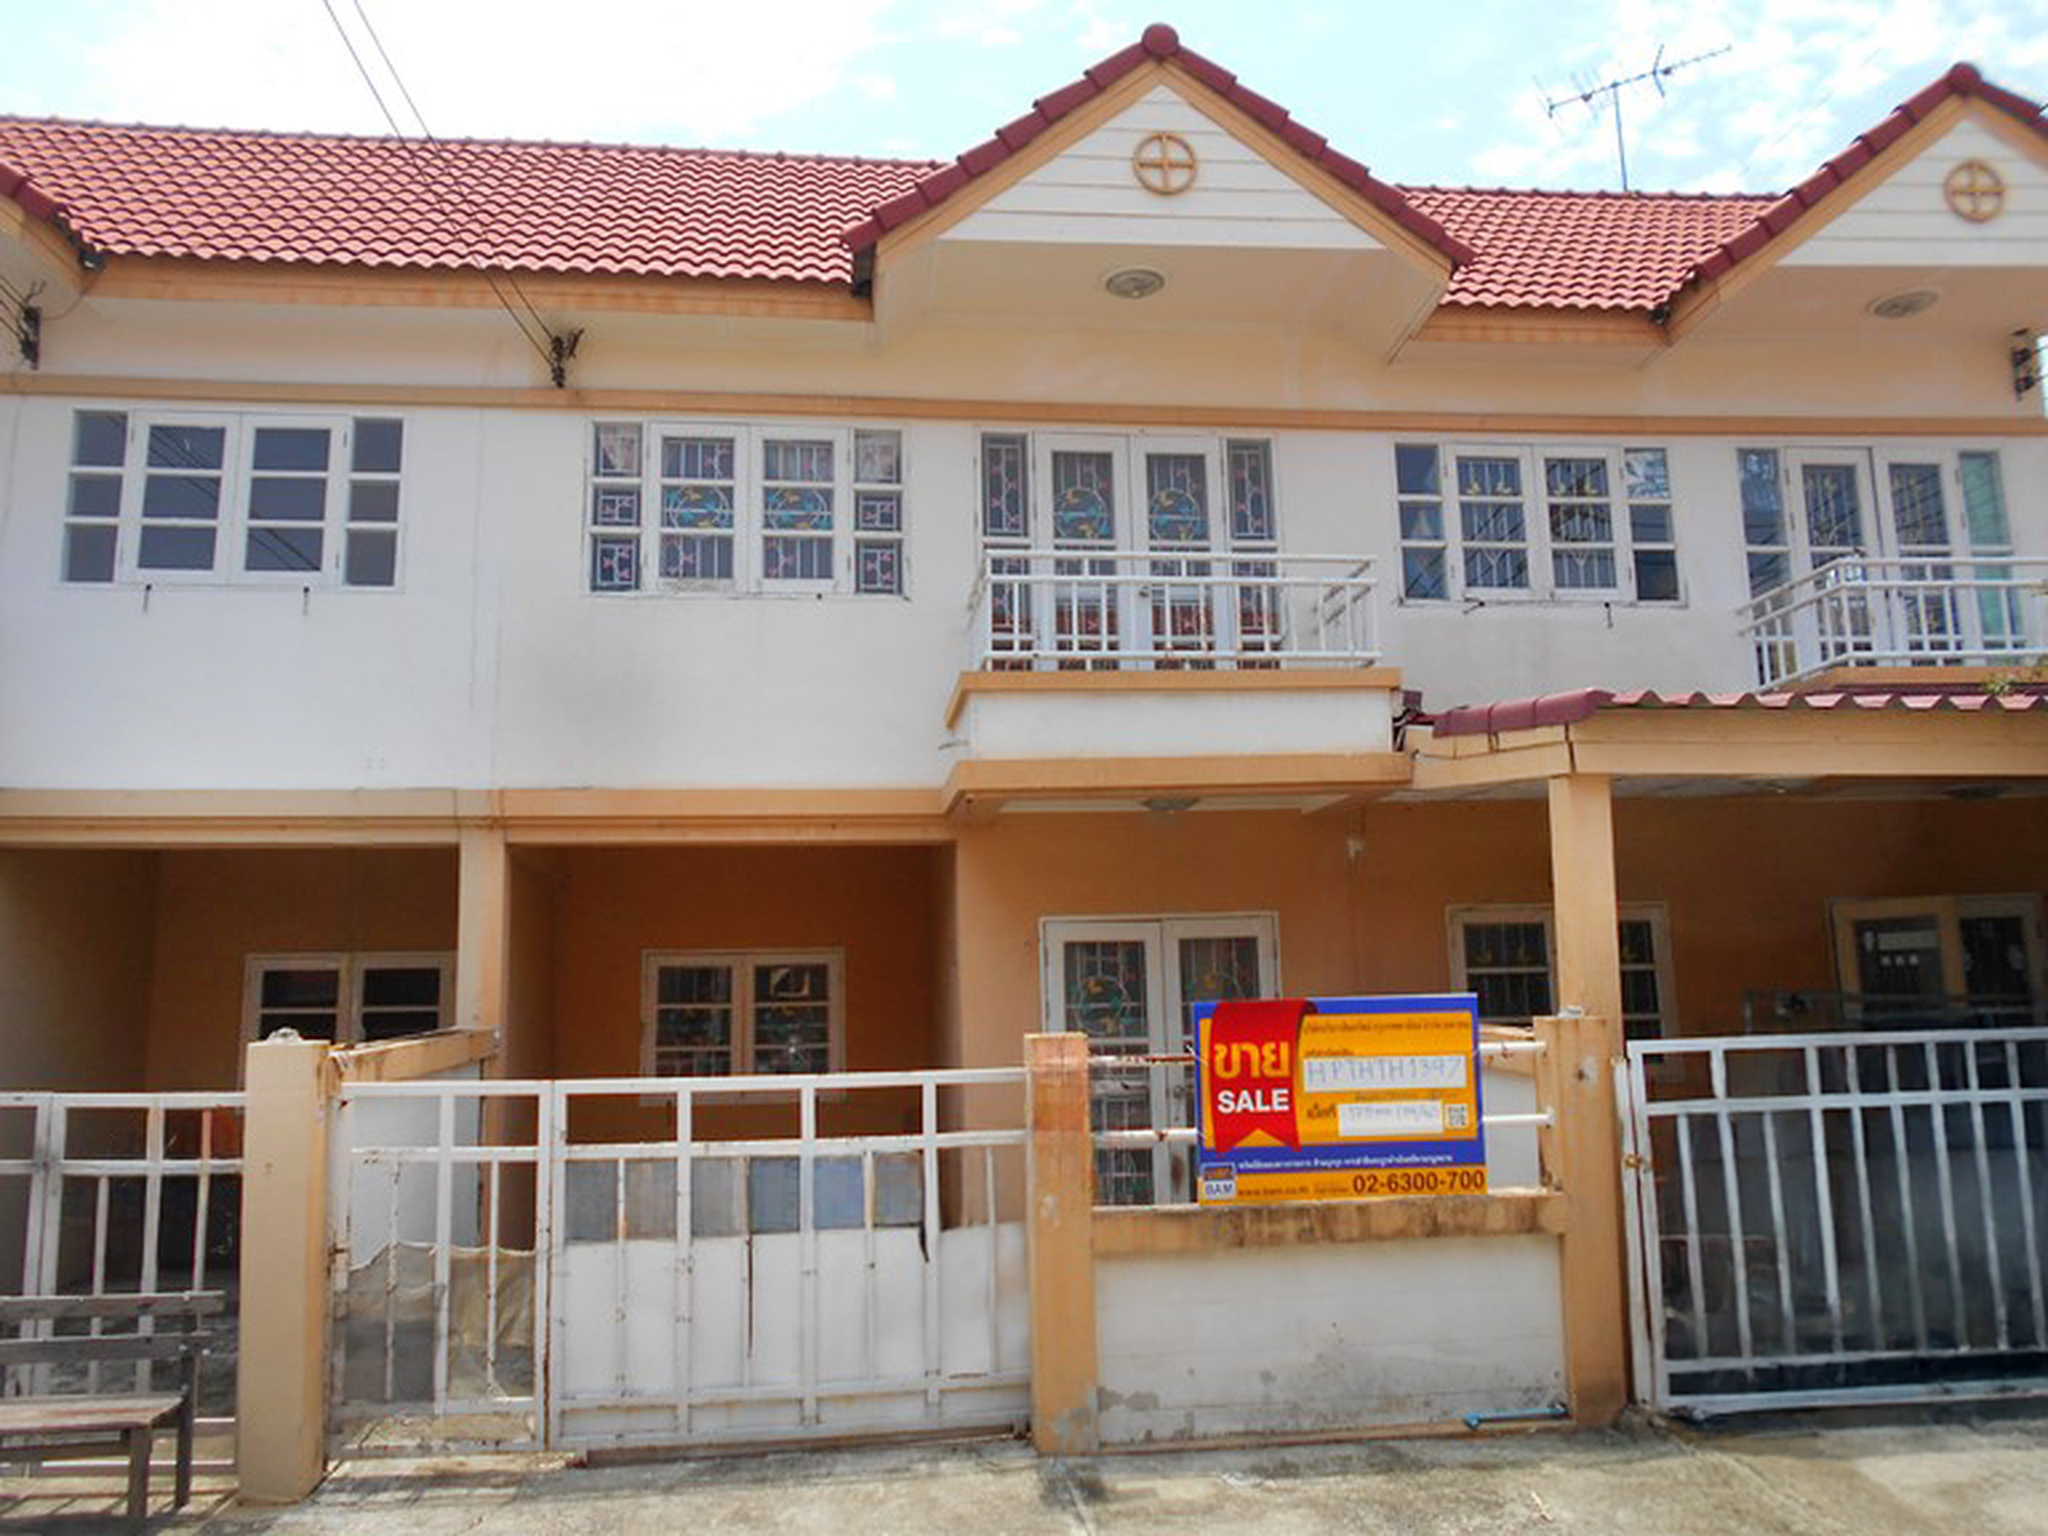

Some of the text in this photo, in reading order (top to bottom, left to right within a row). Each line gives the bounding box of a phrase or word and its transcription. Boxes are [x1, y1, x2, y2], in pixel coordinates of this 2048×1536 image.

[1213, 1041, 1290, 1079] ขาย
[1216, 1088, 1291, 1114] SALE
[1352, 1170, 1485, 1194] 02-6300-700
